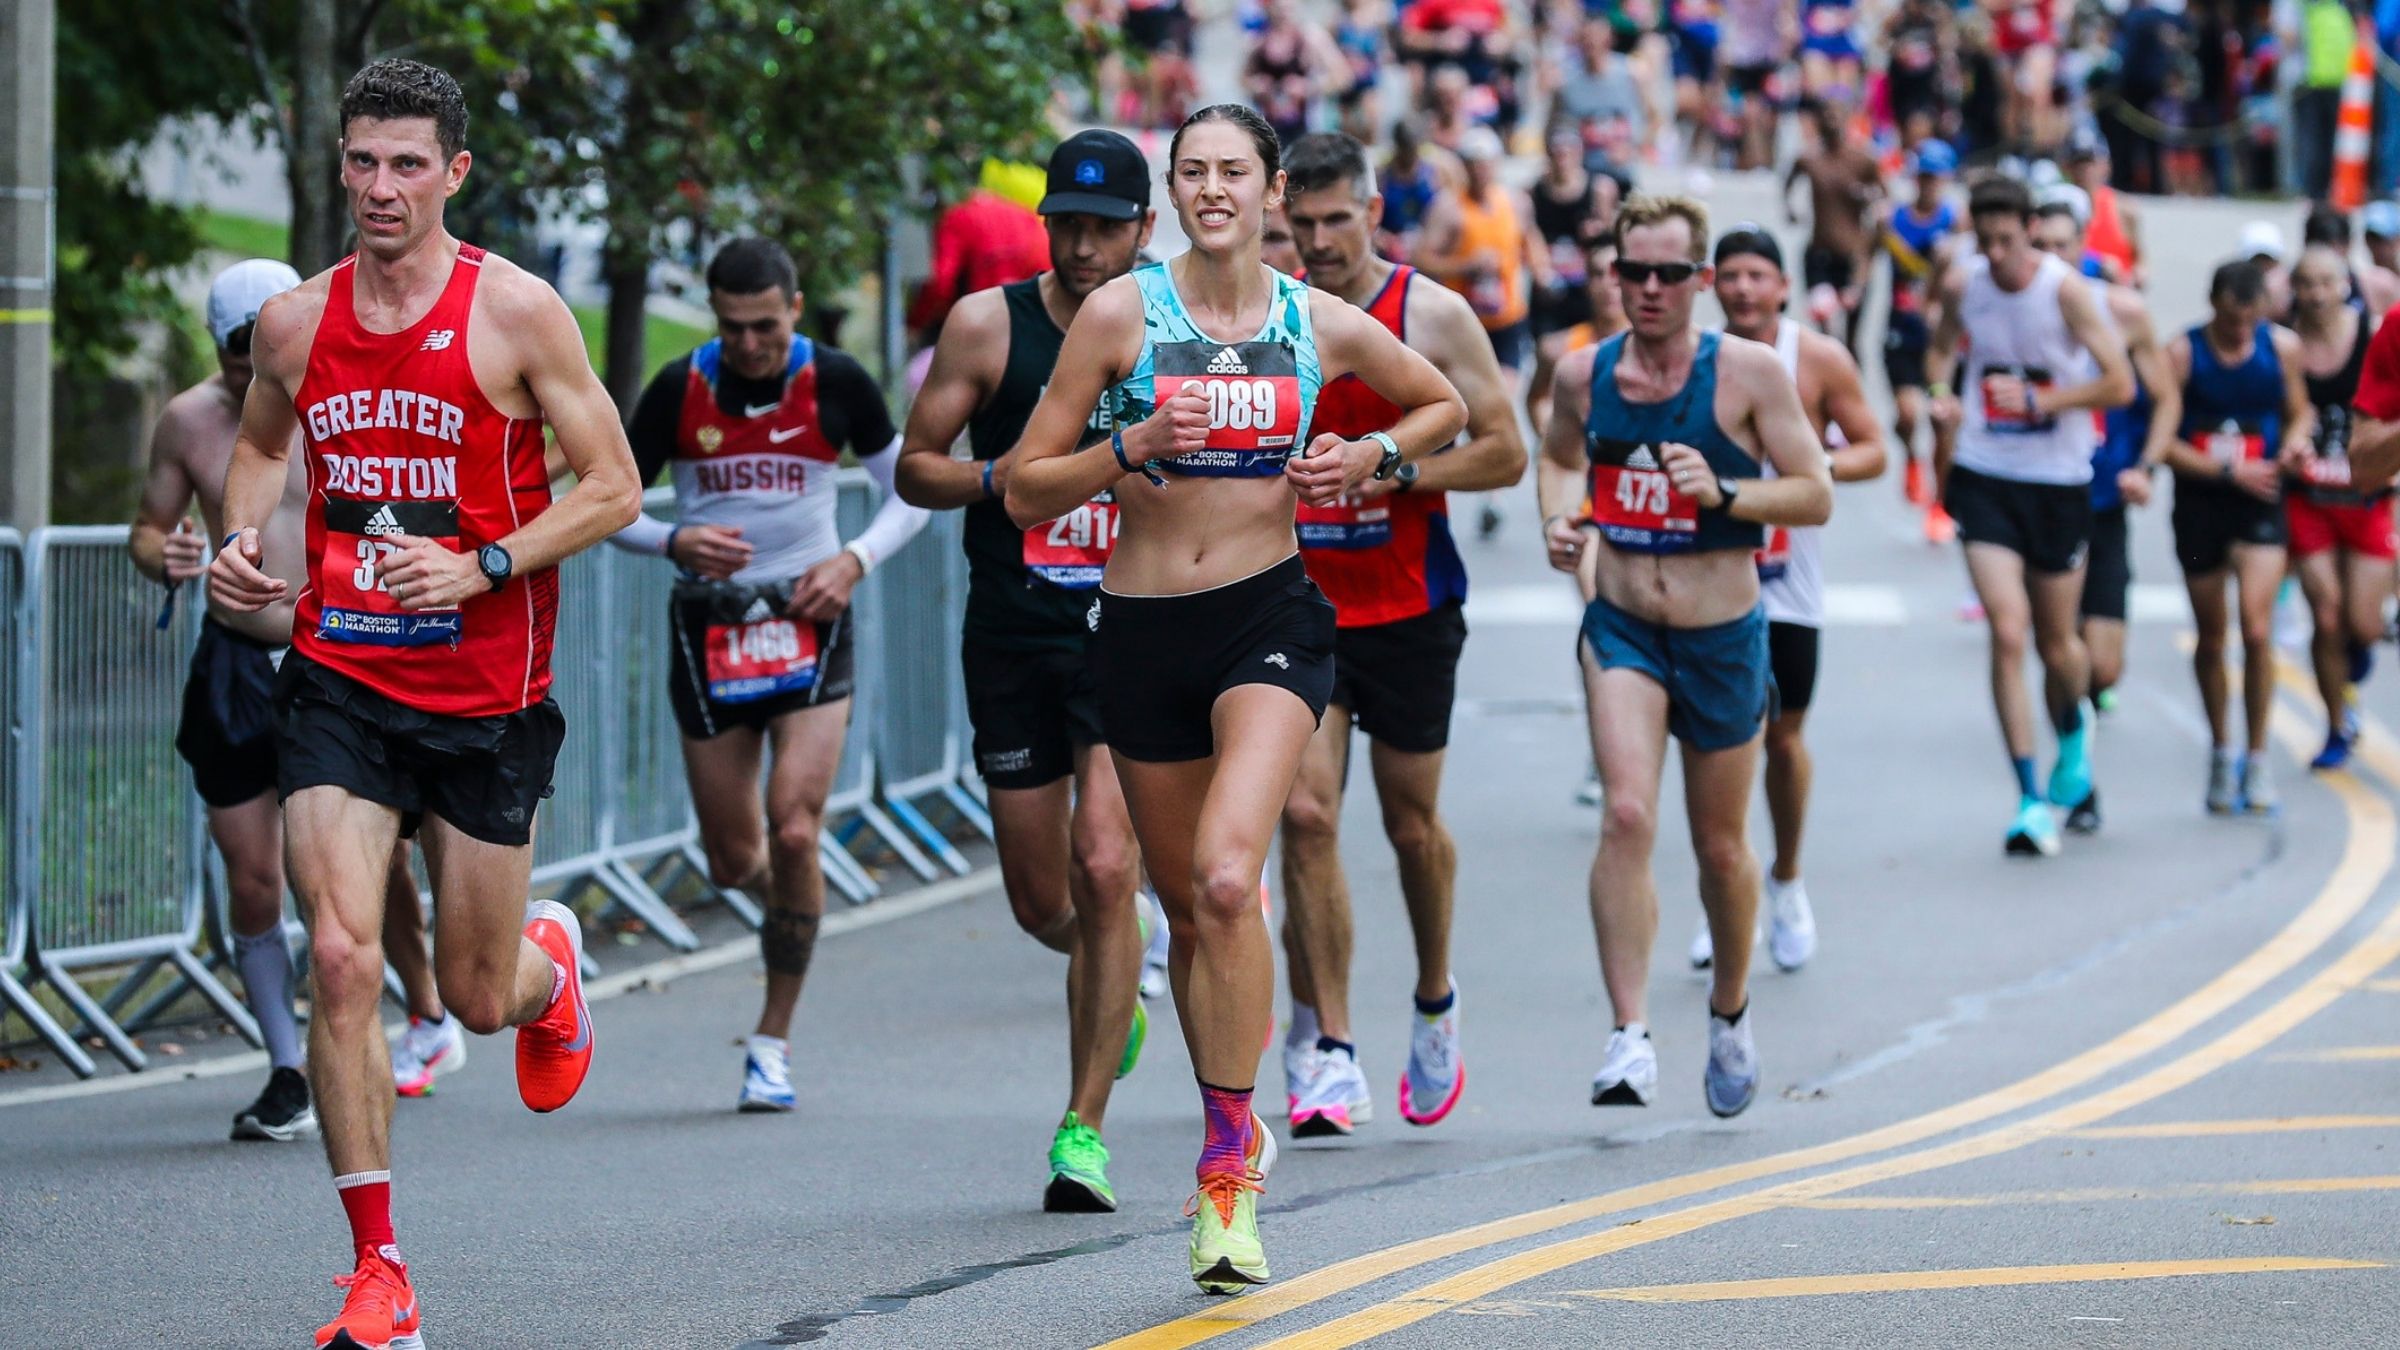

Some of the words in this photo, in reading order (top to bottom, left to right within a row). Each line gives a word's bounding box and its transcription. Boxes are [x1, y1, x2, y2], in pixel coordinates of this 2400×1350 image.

[1207, 362, 1248, 374] adidas
[307, 388, 464, 445] GREATER
[1182, 379, 1276, 430] 089
[1177, 457, 1237, 467] MARATHON
[1198, 451, 1237, 459] BOSTON
[322, 453, 456, 498] BOSTON
[697, 459, 805, 496] RUSSIA
[1615, 469, 1670, 515] 473
[364, 524, 405, 535] adidas
[353, 539, 402, 592] 37
[344, 623, 400, 634] MARATHON
[363, 615, 398, 625] BOSTON
